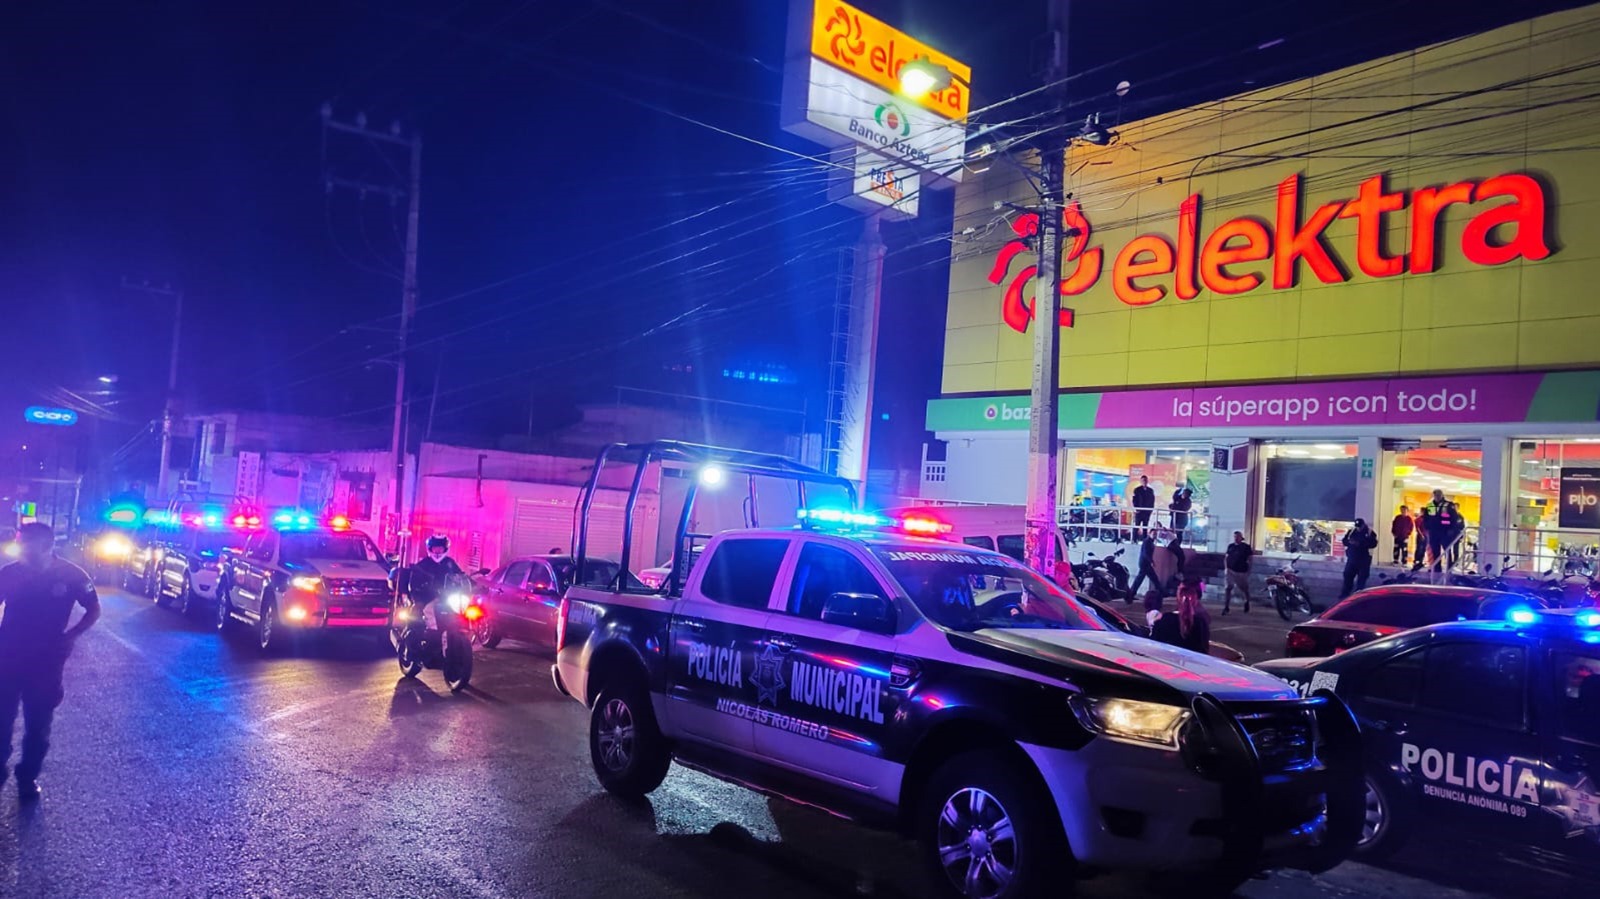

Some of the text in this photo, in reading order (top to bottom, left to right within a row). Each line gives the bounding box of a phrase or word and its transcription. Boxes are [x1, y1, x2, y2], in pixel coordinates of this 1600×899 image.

[849, 119, 888, 146] Banco
[1112, 173, 1551, 306] elektra
[1172, 388, 1477, 422] la súperapp ¡con todo!
[688, 640, 885, 725] POLICÍA MUNICIPAL
[770, 713, 830, 741] ROMERO
[1401, 742, 1540, 804] POLICÍA
[1423, 784, 1467, 803] DENUNCIA
[1510, 806, 1527, 818] 089
